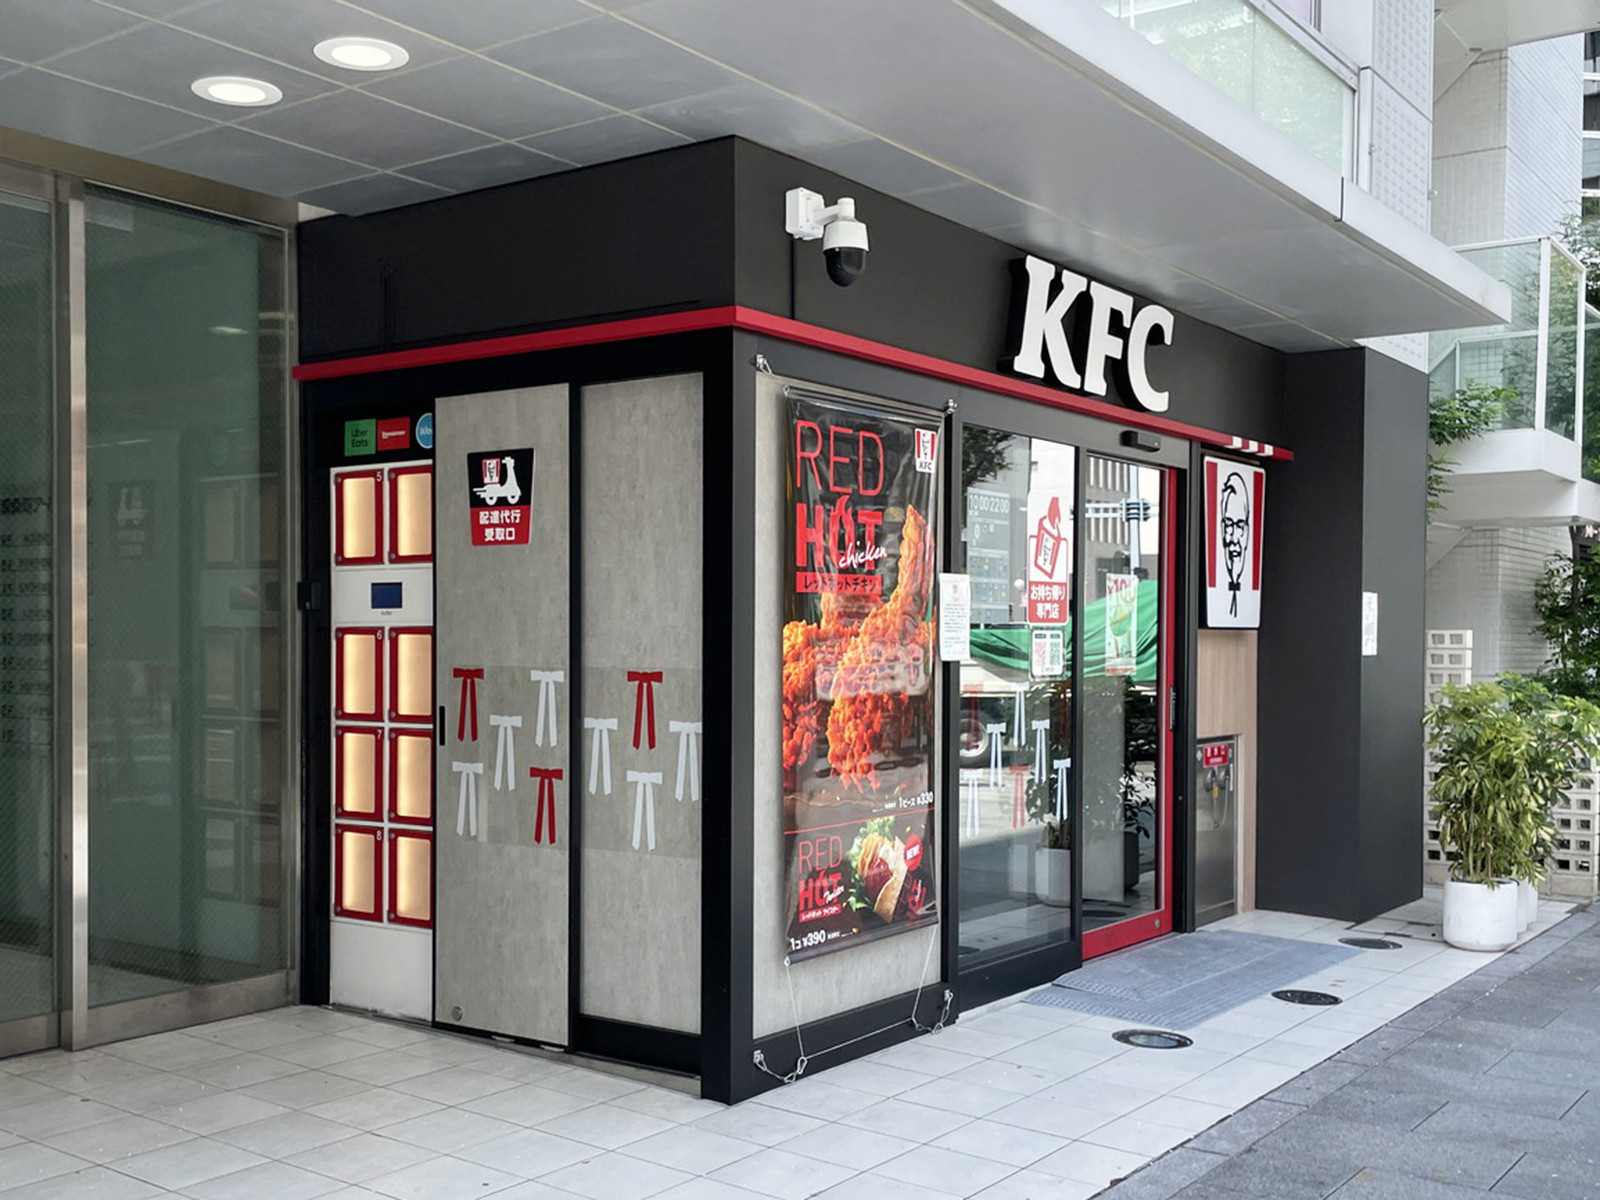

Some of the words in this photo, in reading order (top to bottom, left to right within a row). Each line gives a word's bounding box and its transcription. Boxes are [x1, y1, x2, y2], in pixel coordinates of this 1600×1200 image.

[1012, 254, 1175, 413] KFC
[351, 428, 369, 438] Uber
[351, 438, 369, 448] Eats
[796, 419, 884, 496] RED
[918, 459, 933, 471] KFC
[376, 470, 383, 483] 5
[479, 509, 521, 525] 配達代行
[484, 527, 516, 542] 受取口
[796, 494, 883, 571] HOT
[838, 540, 888, 569] chicken
[1030, 584, 1066, 601] お持ち帰り
[1036, 602, 1060, 619] 専門店
[376, 629, 383, 640] 6
[376, 728, 383, 740] 7
[375, 830, 383, 842] 8
[799, 835, 843, 874] RED
[799, 869, 842, 911] HOT
[803, 929, 826, 947] ¥390
